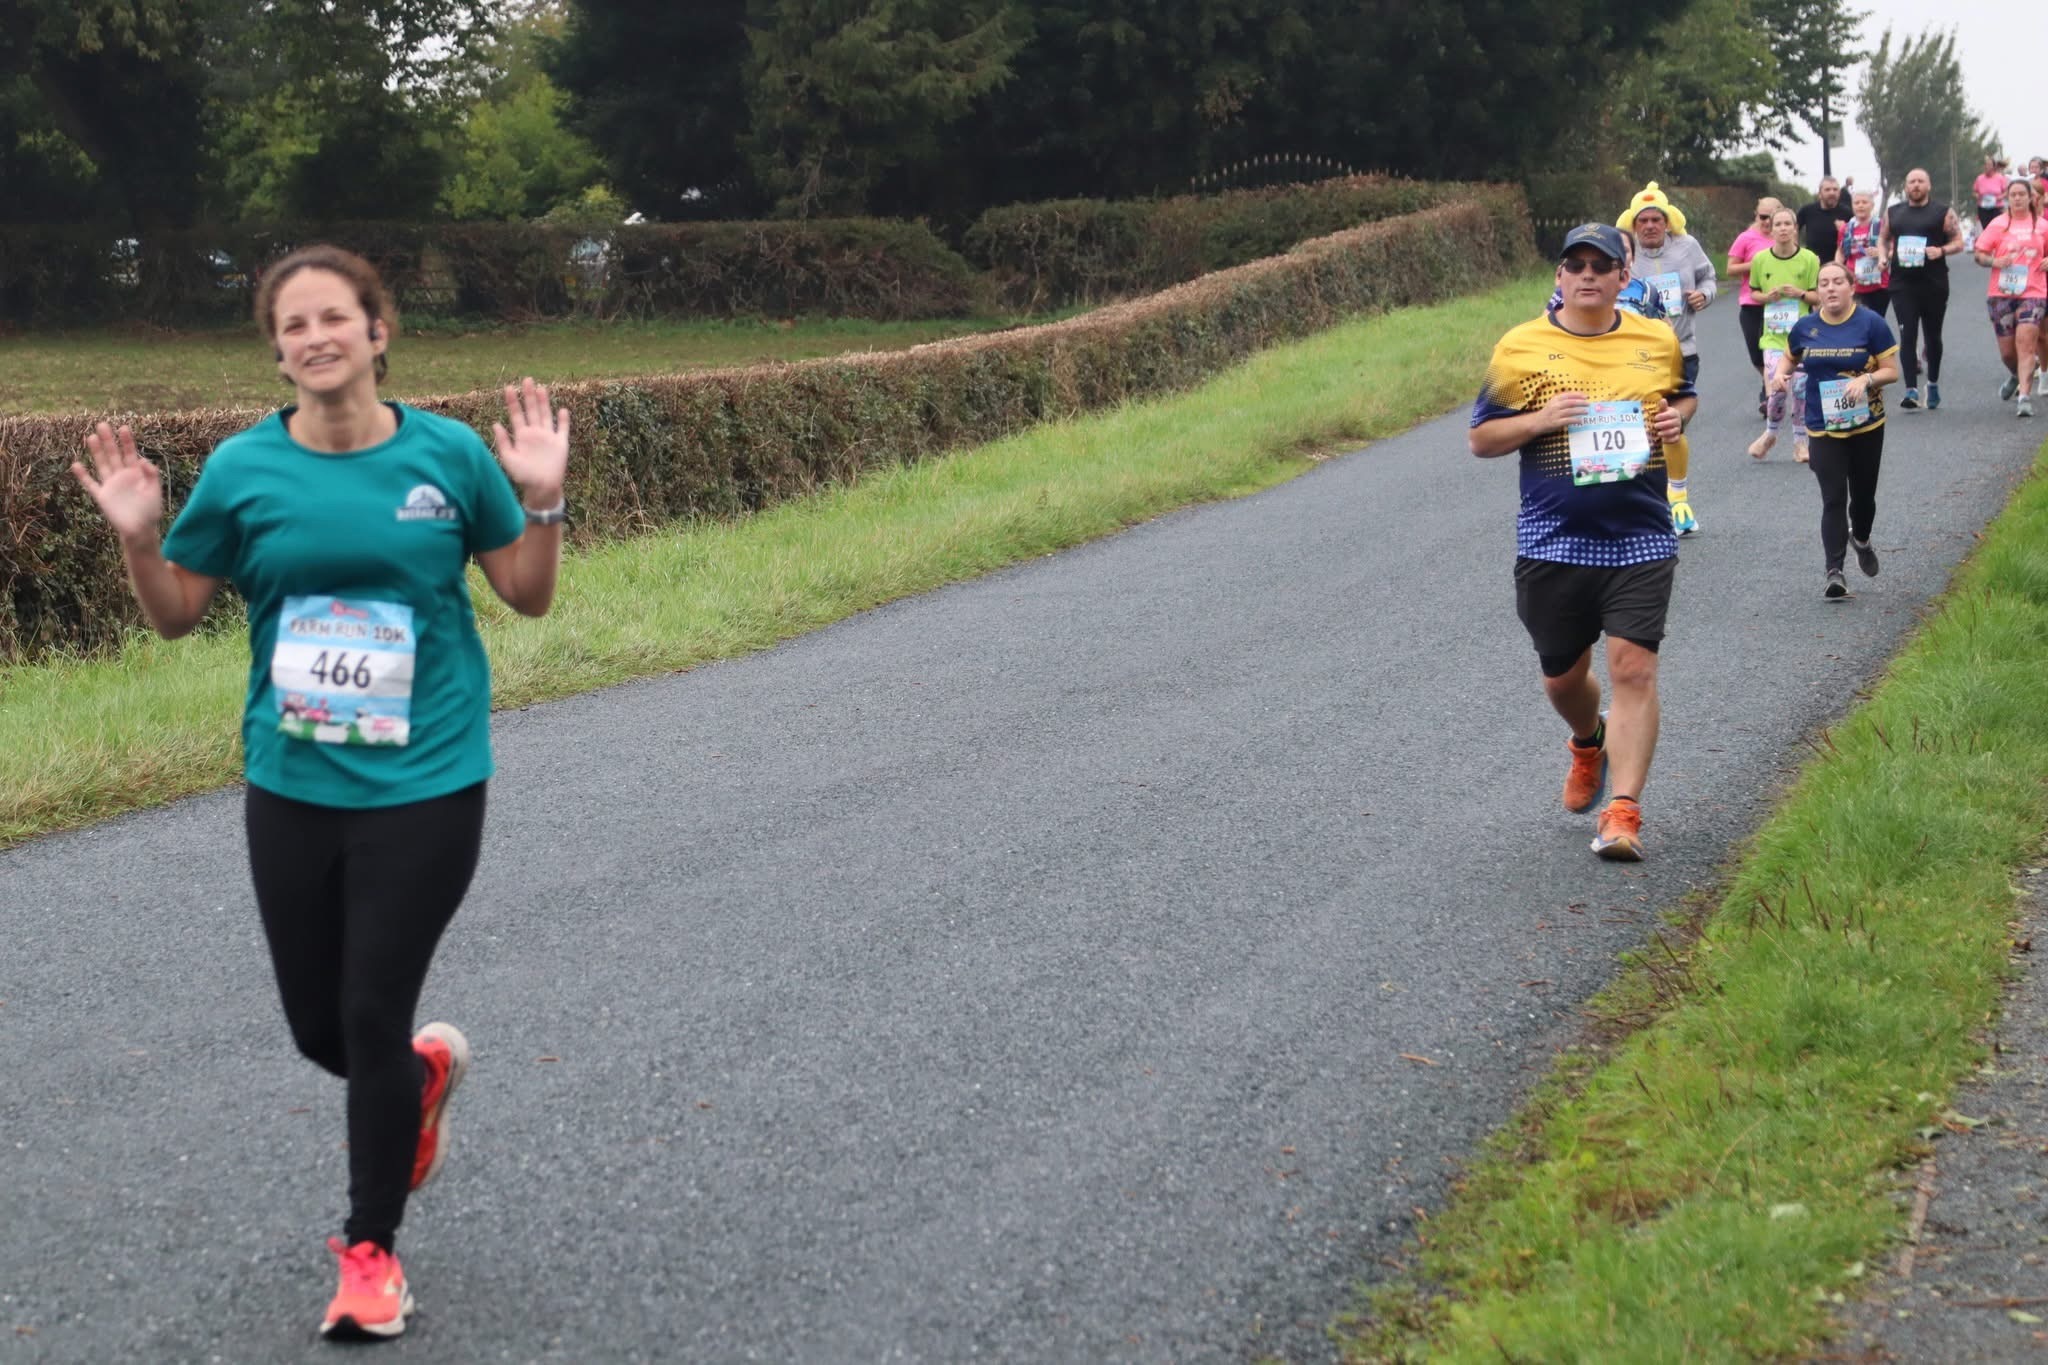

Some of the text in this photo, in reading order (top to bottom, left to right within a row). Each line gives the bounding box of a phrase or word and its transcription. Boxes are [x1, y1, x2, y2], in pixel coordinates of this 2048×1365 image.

[1548, 353, 1565, 361] DC
[1598, 415, 1617, 424] RUN
[1620, 413, 1639, 423] 10K
[1592, 430, 1626, 452] 120
[290, 617, 407, 643] FARM RUN 10K
[310, 650, 371, 689] 466
